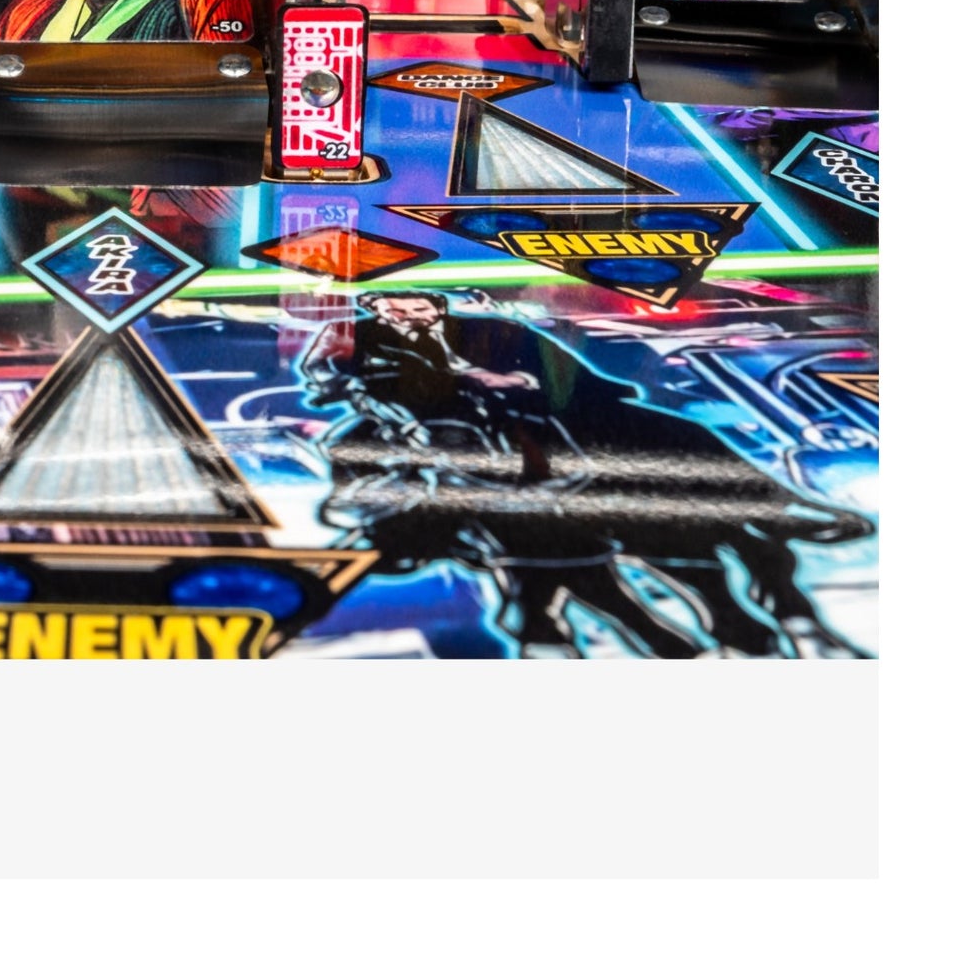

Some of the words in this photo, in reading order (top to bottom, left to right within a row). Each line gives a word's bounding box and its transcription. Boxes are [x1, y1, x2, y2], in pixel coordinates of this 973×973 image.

[211, 20, 243, 33] -50
[397, 74, 504, 82] DANCE
[414, 81, 498, 89] CLUB
[319, 143, 349, 160] -22
[511, 233, 702, 256] ENEMY
[85, 234, 139, 295] AKIRA
